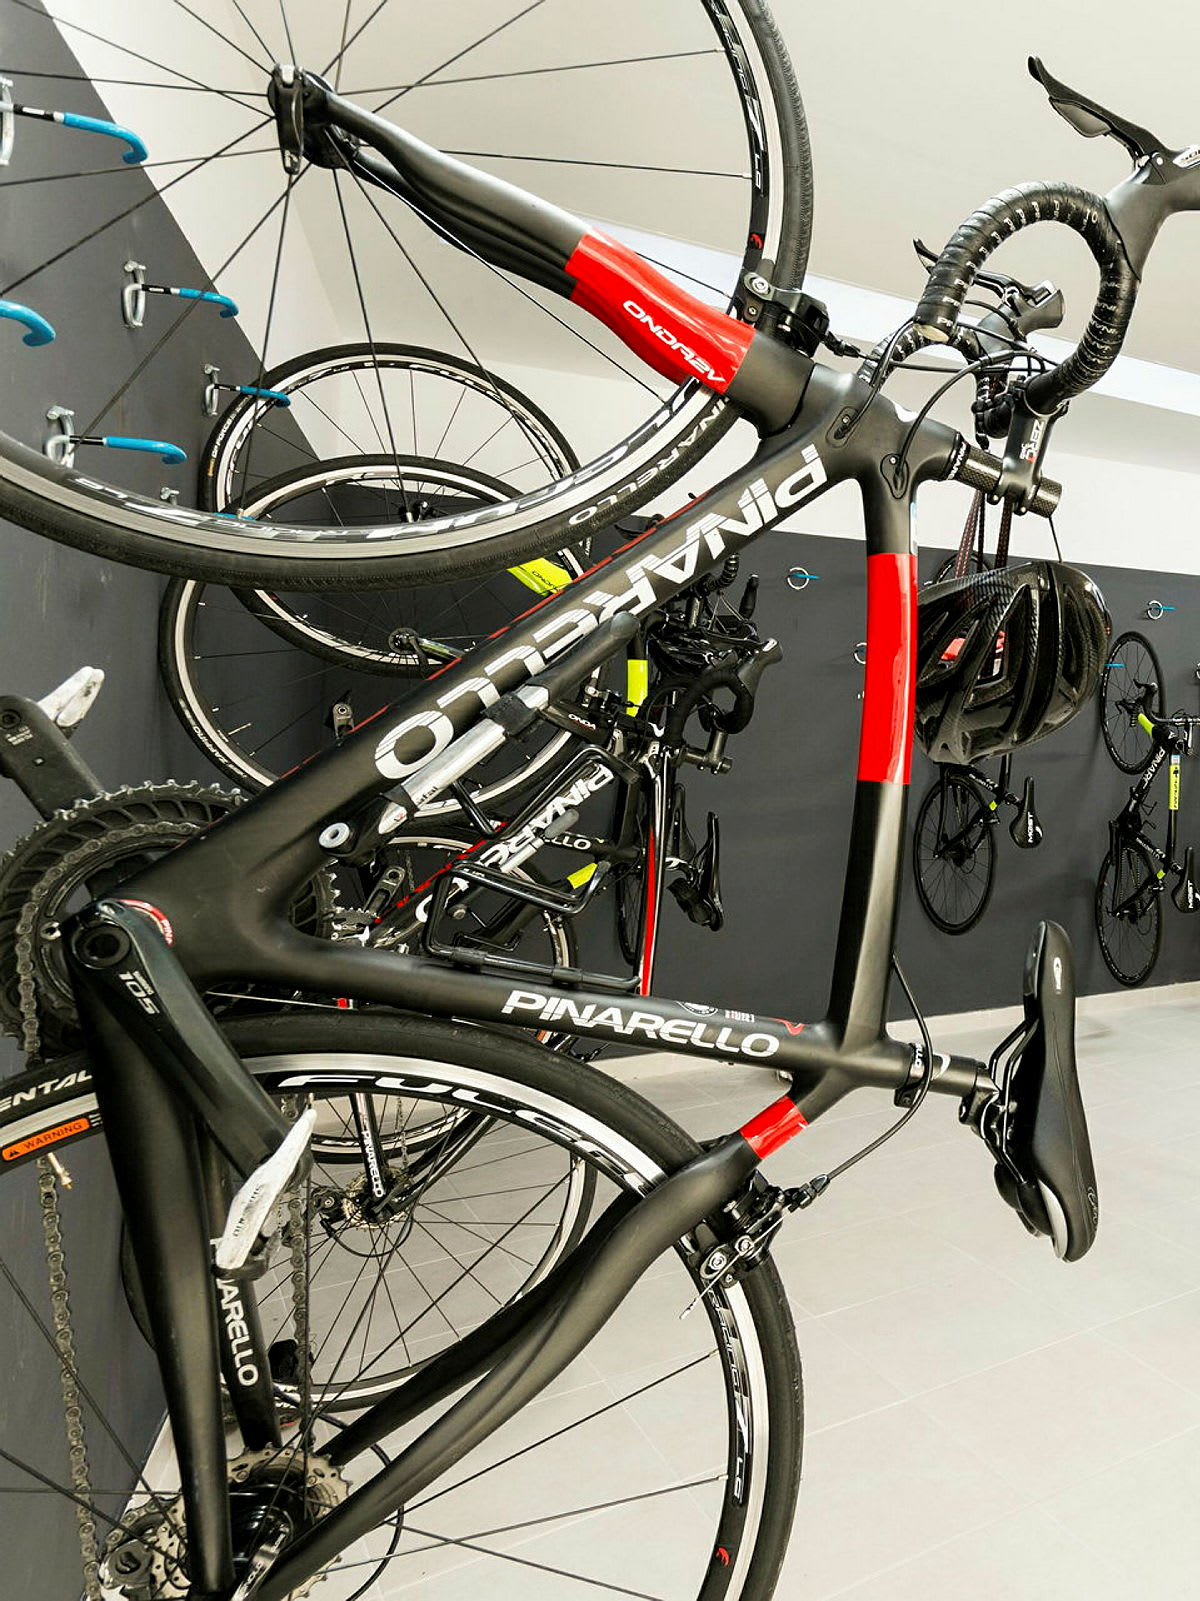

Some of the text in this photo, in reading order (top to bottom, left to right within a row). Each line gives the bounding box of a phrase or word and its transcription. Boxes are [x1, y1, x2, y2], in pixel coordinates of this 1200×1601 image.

[567, 397, 730, 526] INARELLO
[374, 444, 829, 781] PINARELLO
[119, 971, 160, 1015] 105
[500, 989, 780, 1058] PINARELLO
[24, 1122, 83, 1150] WARNING
[361, 1131, 385, 1198] PINARELLO
